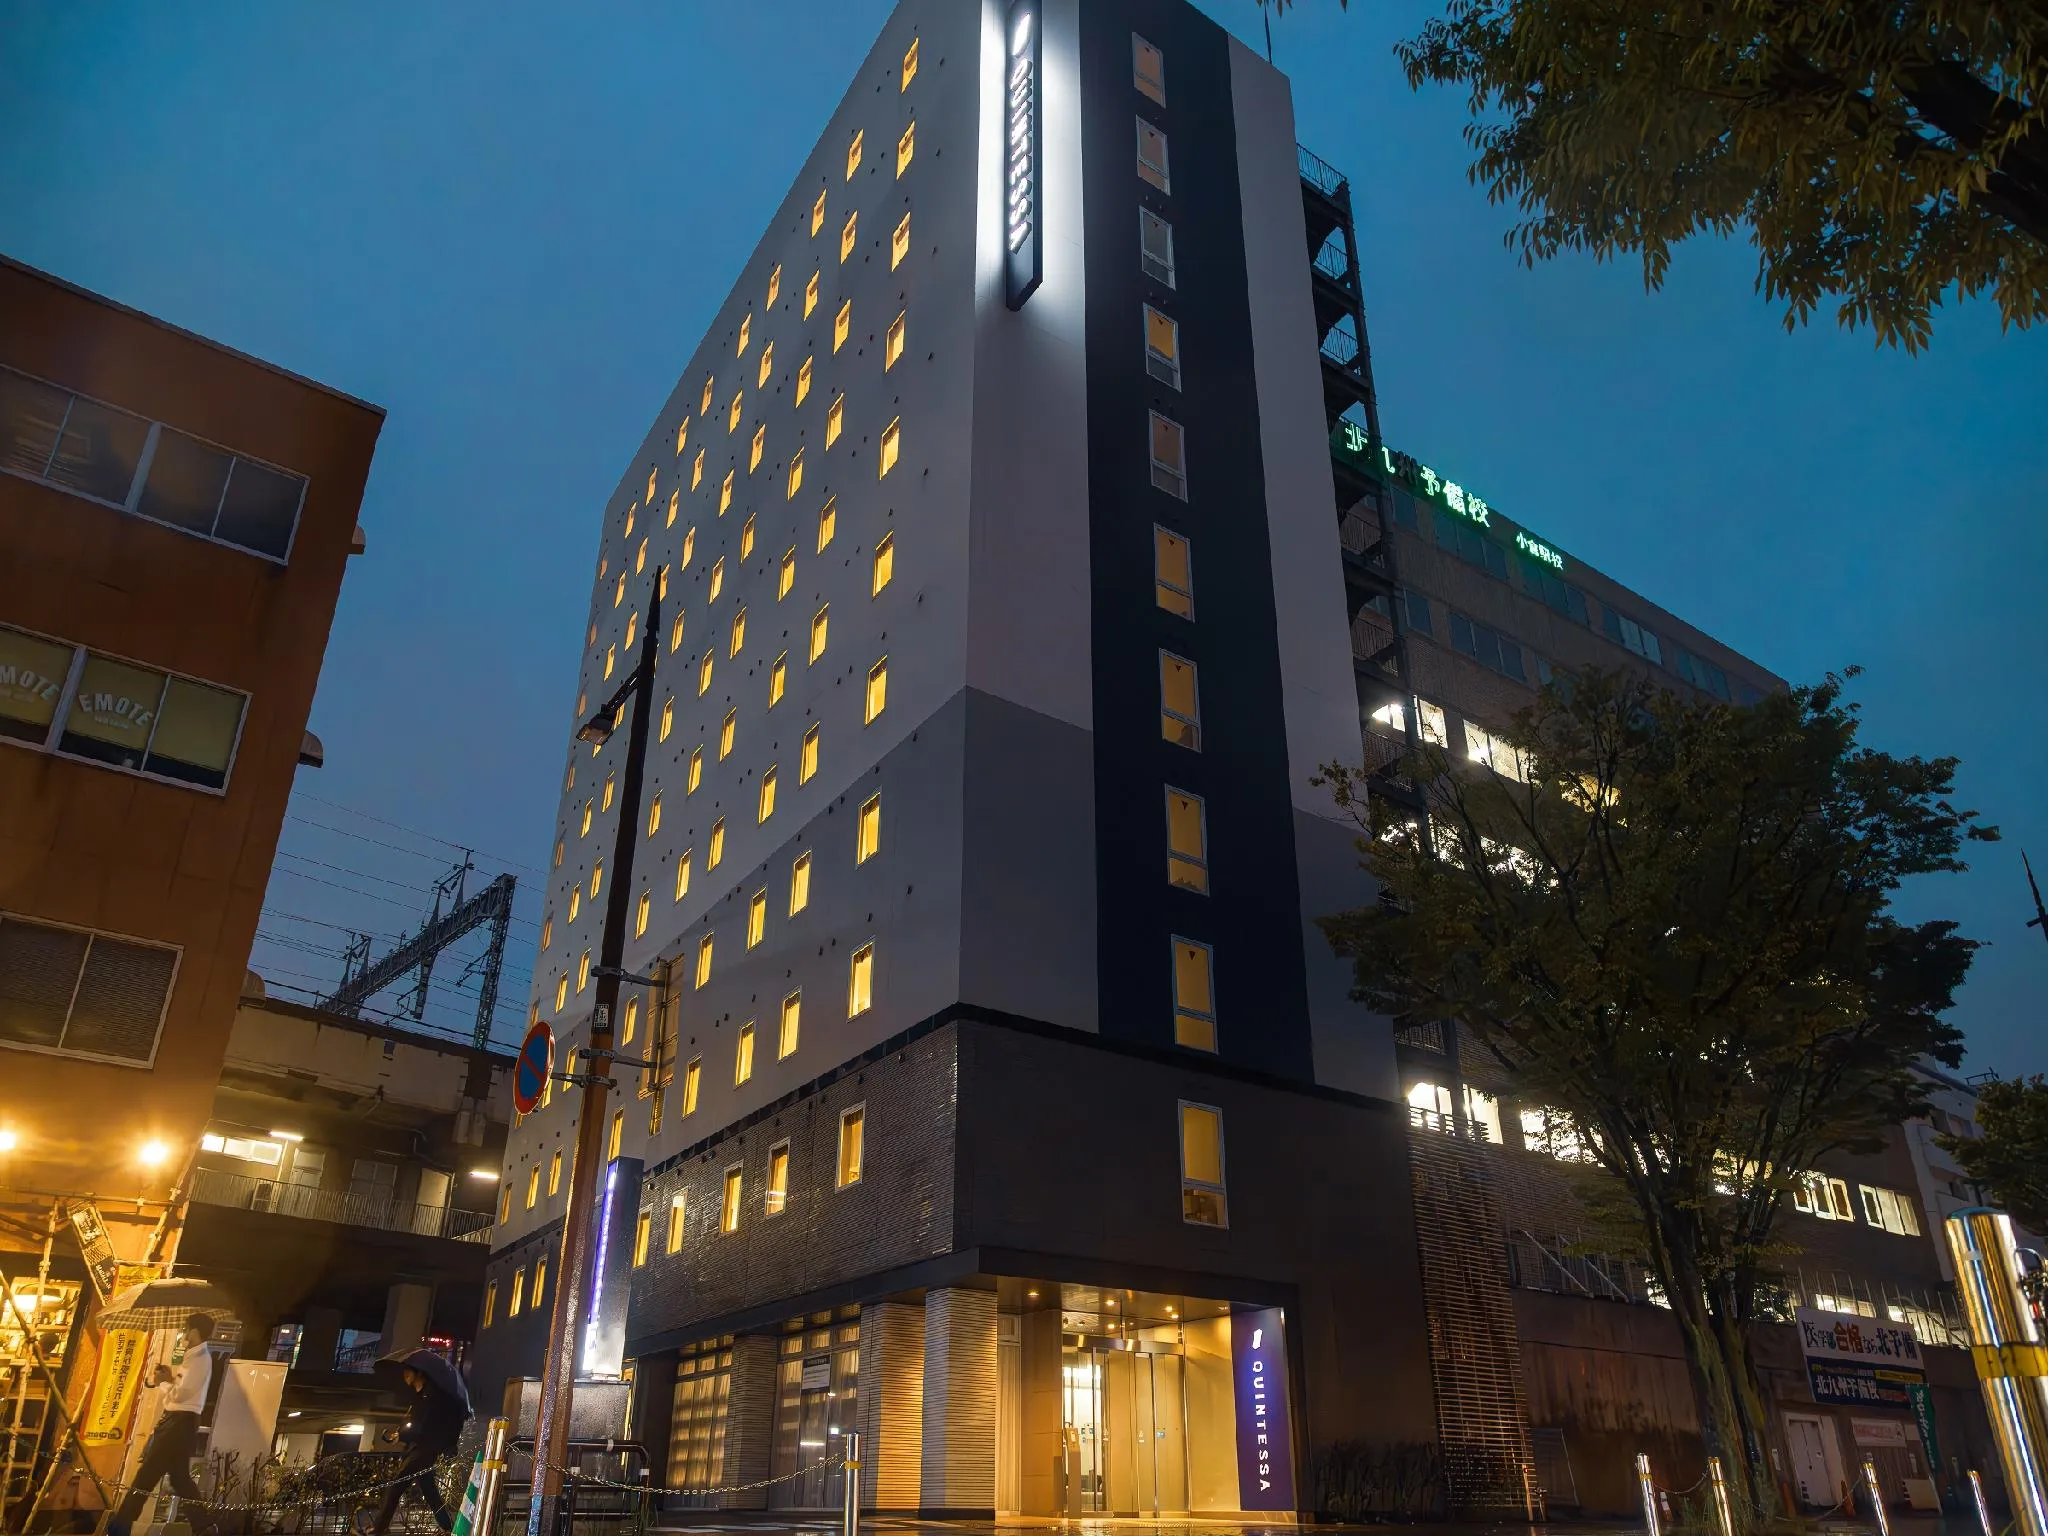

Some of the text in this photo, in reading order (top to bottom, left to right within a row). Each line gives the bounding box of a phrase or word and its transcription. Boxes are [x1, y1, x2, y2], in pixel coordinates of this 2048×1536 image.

[1009, 58, 1033, 254] QUINTESSA
[79, 693, 154, 727] EMOTE
[1251, 1360, 1271, 1492] QUINTESSA
